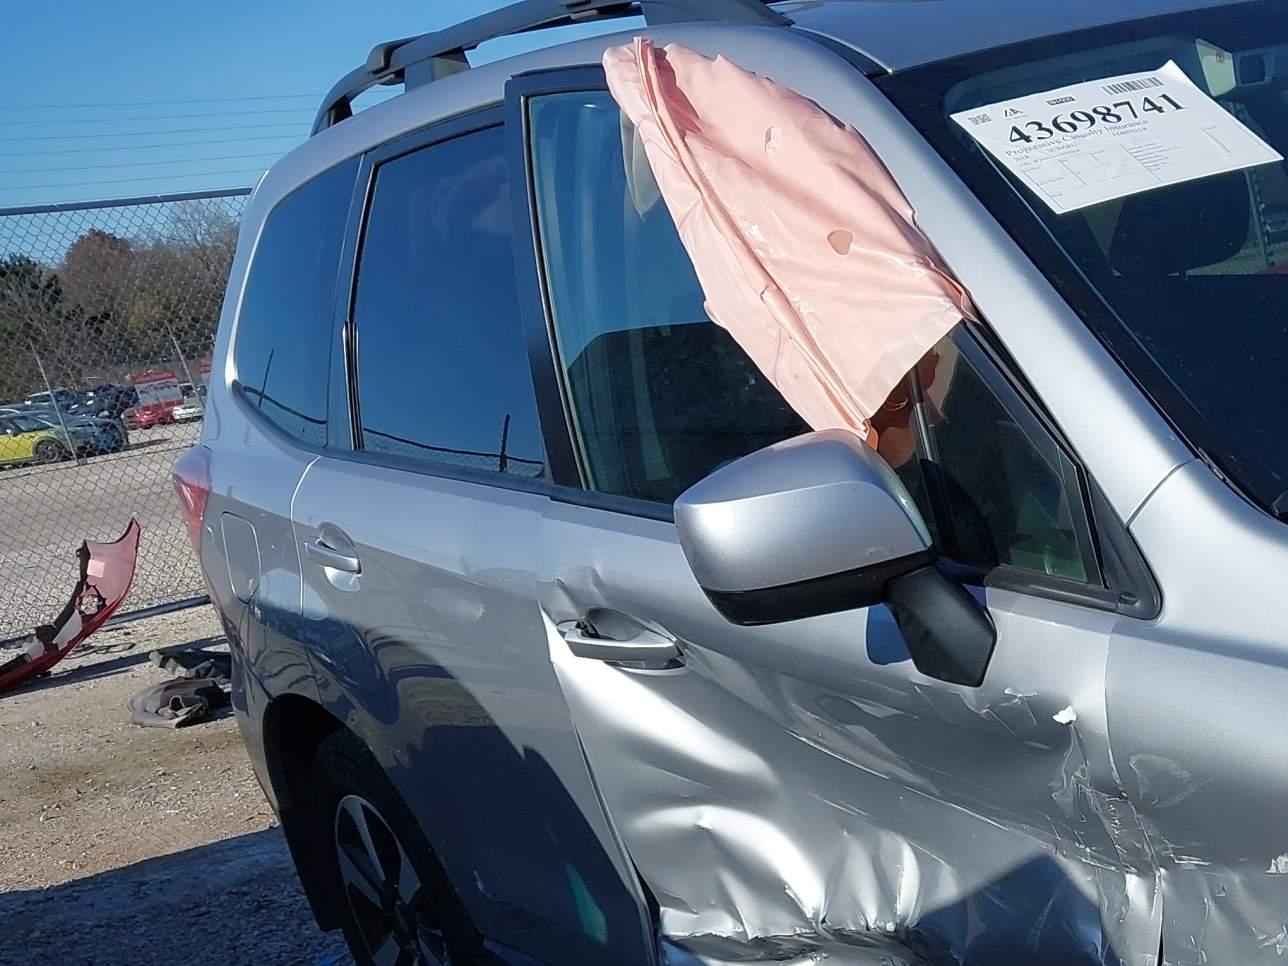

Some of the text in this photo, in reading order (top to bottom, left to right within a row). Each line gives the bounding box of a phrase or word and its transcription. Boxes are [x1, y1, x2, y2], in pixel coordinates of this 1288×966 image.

[1009, 93, 1187, 143] 43698741
[1006, 140, 1061, 157] Progressive
[1062, 129, 1103, 142] Casualty
